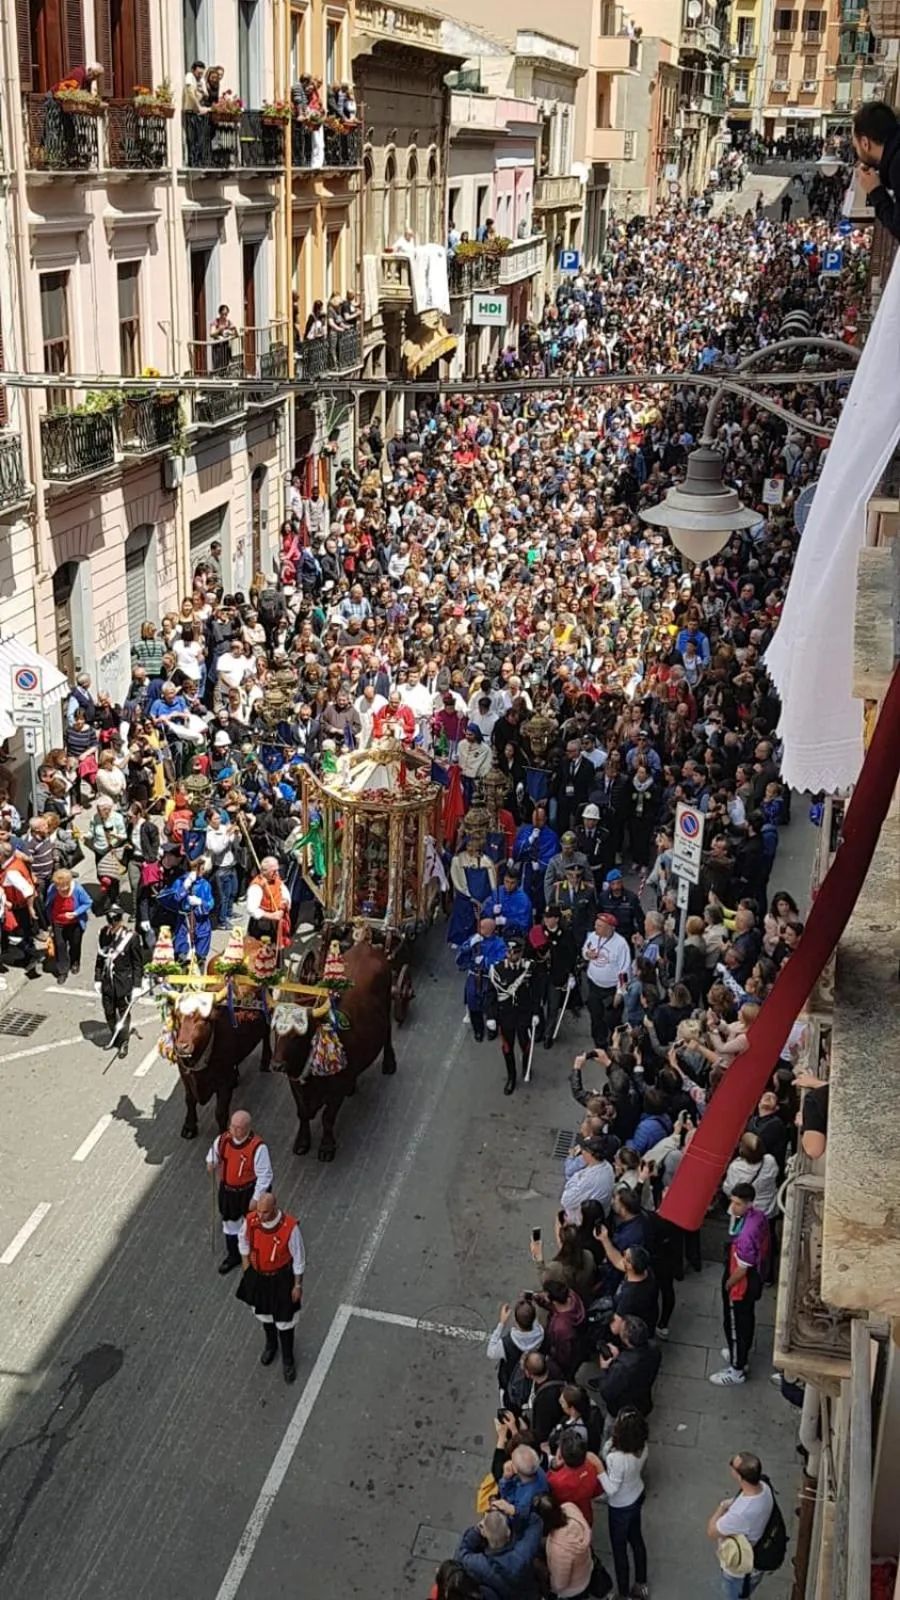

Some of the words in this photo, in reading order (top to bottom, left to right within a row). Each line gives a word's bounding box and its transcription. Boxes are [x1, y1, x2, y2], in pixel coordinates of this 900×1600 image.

[563, 252, 576, 268] P
[826, 252, 839, 269] P
[479, 302, 502, 314] HDI
